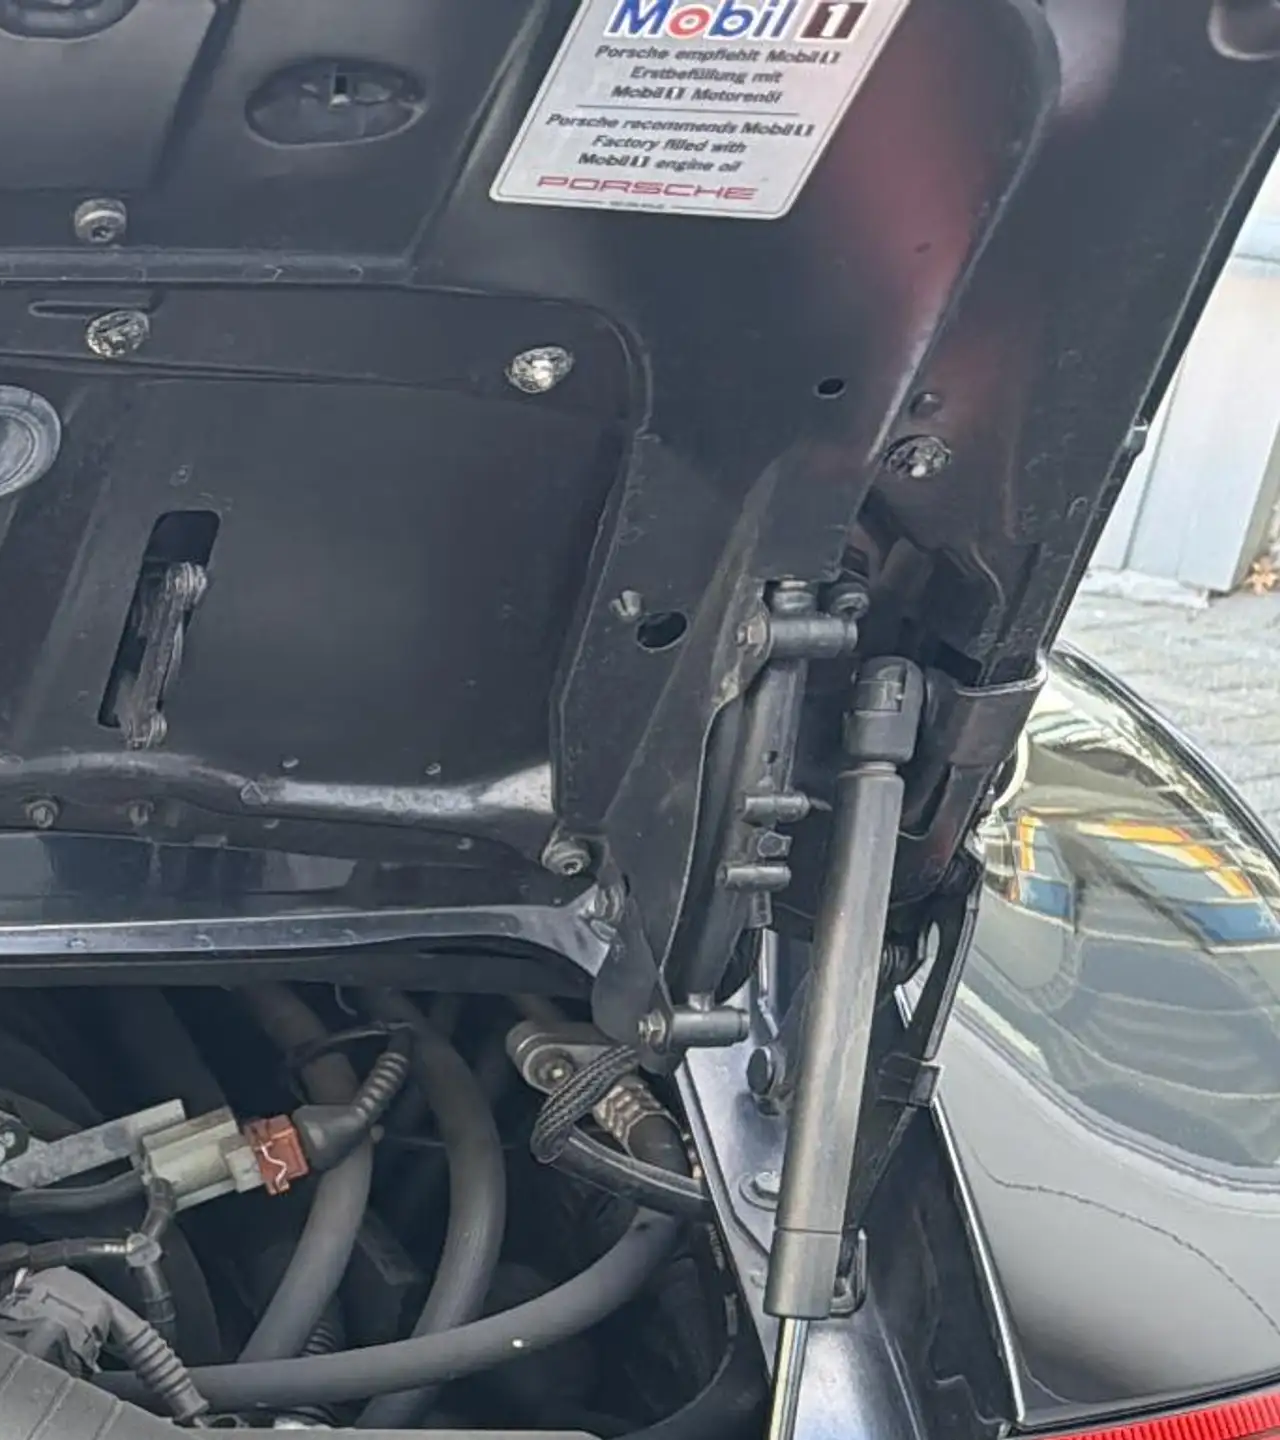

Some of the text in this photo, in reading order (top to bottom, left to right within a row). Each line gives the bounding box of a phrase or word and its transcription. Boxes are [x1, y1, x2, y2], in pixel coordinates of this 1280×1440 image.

[606, 0, 798, 38] Mobil
[595, 45, 670, 60] Porsche
[675, 48, 761, 63] empfiehlt
[630, 65, 783, 84] Erstbefüllung mit
[691, 87, 783, 103] Motorenöl
[545, 113, 620, 129] Porsche
[623, 119, 737, 135] recommends
[592, 135, 748, 154] Factory filled with
[654, 158, 716, 174] engine
[718, 161, 743, 173] oil
[536, 175, 759, 200] PORSCHE
